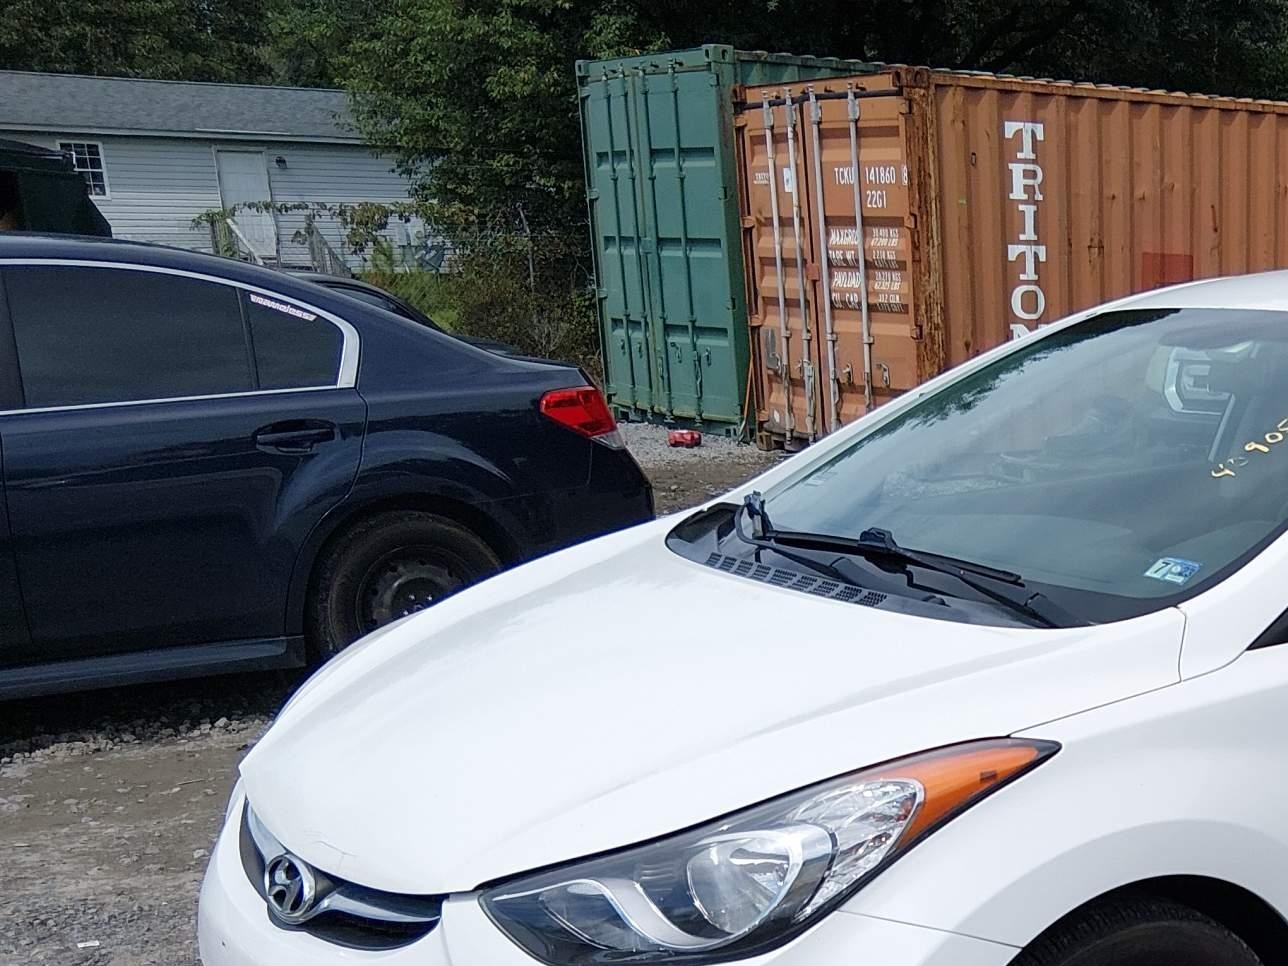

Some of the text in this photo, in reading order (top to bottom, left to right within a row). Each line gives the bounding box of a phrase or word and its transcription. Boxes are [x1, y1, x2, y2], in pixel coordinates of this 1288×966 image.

[834, 167, 855, 185] TCKU
[865, 166, 896, 185] 141860
[866, 190, 887, 208] 22G1
